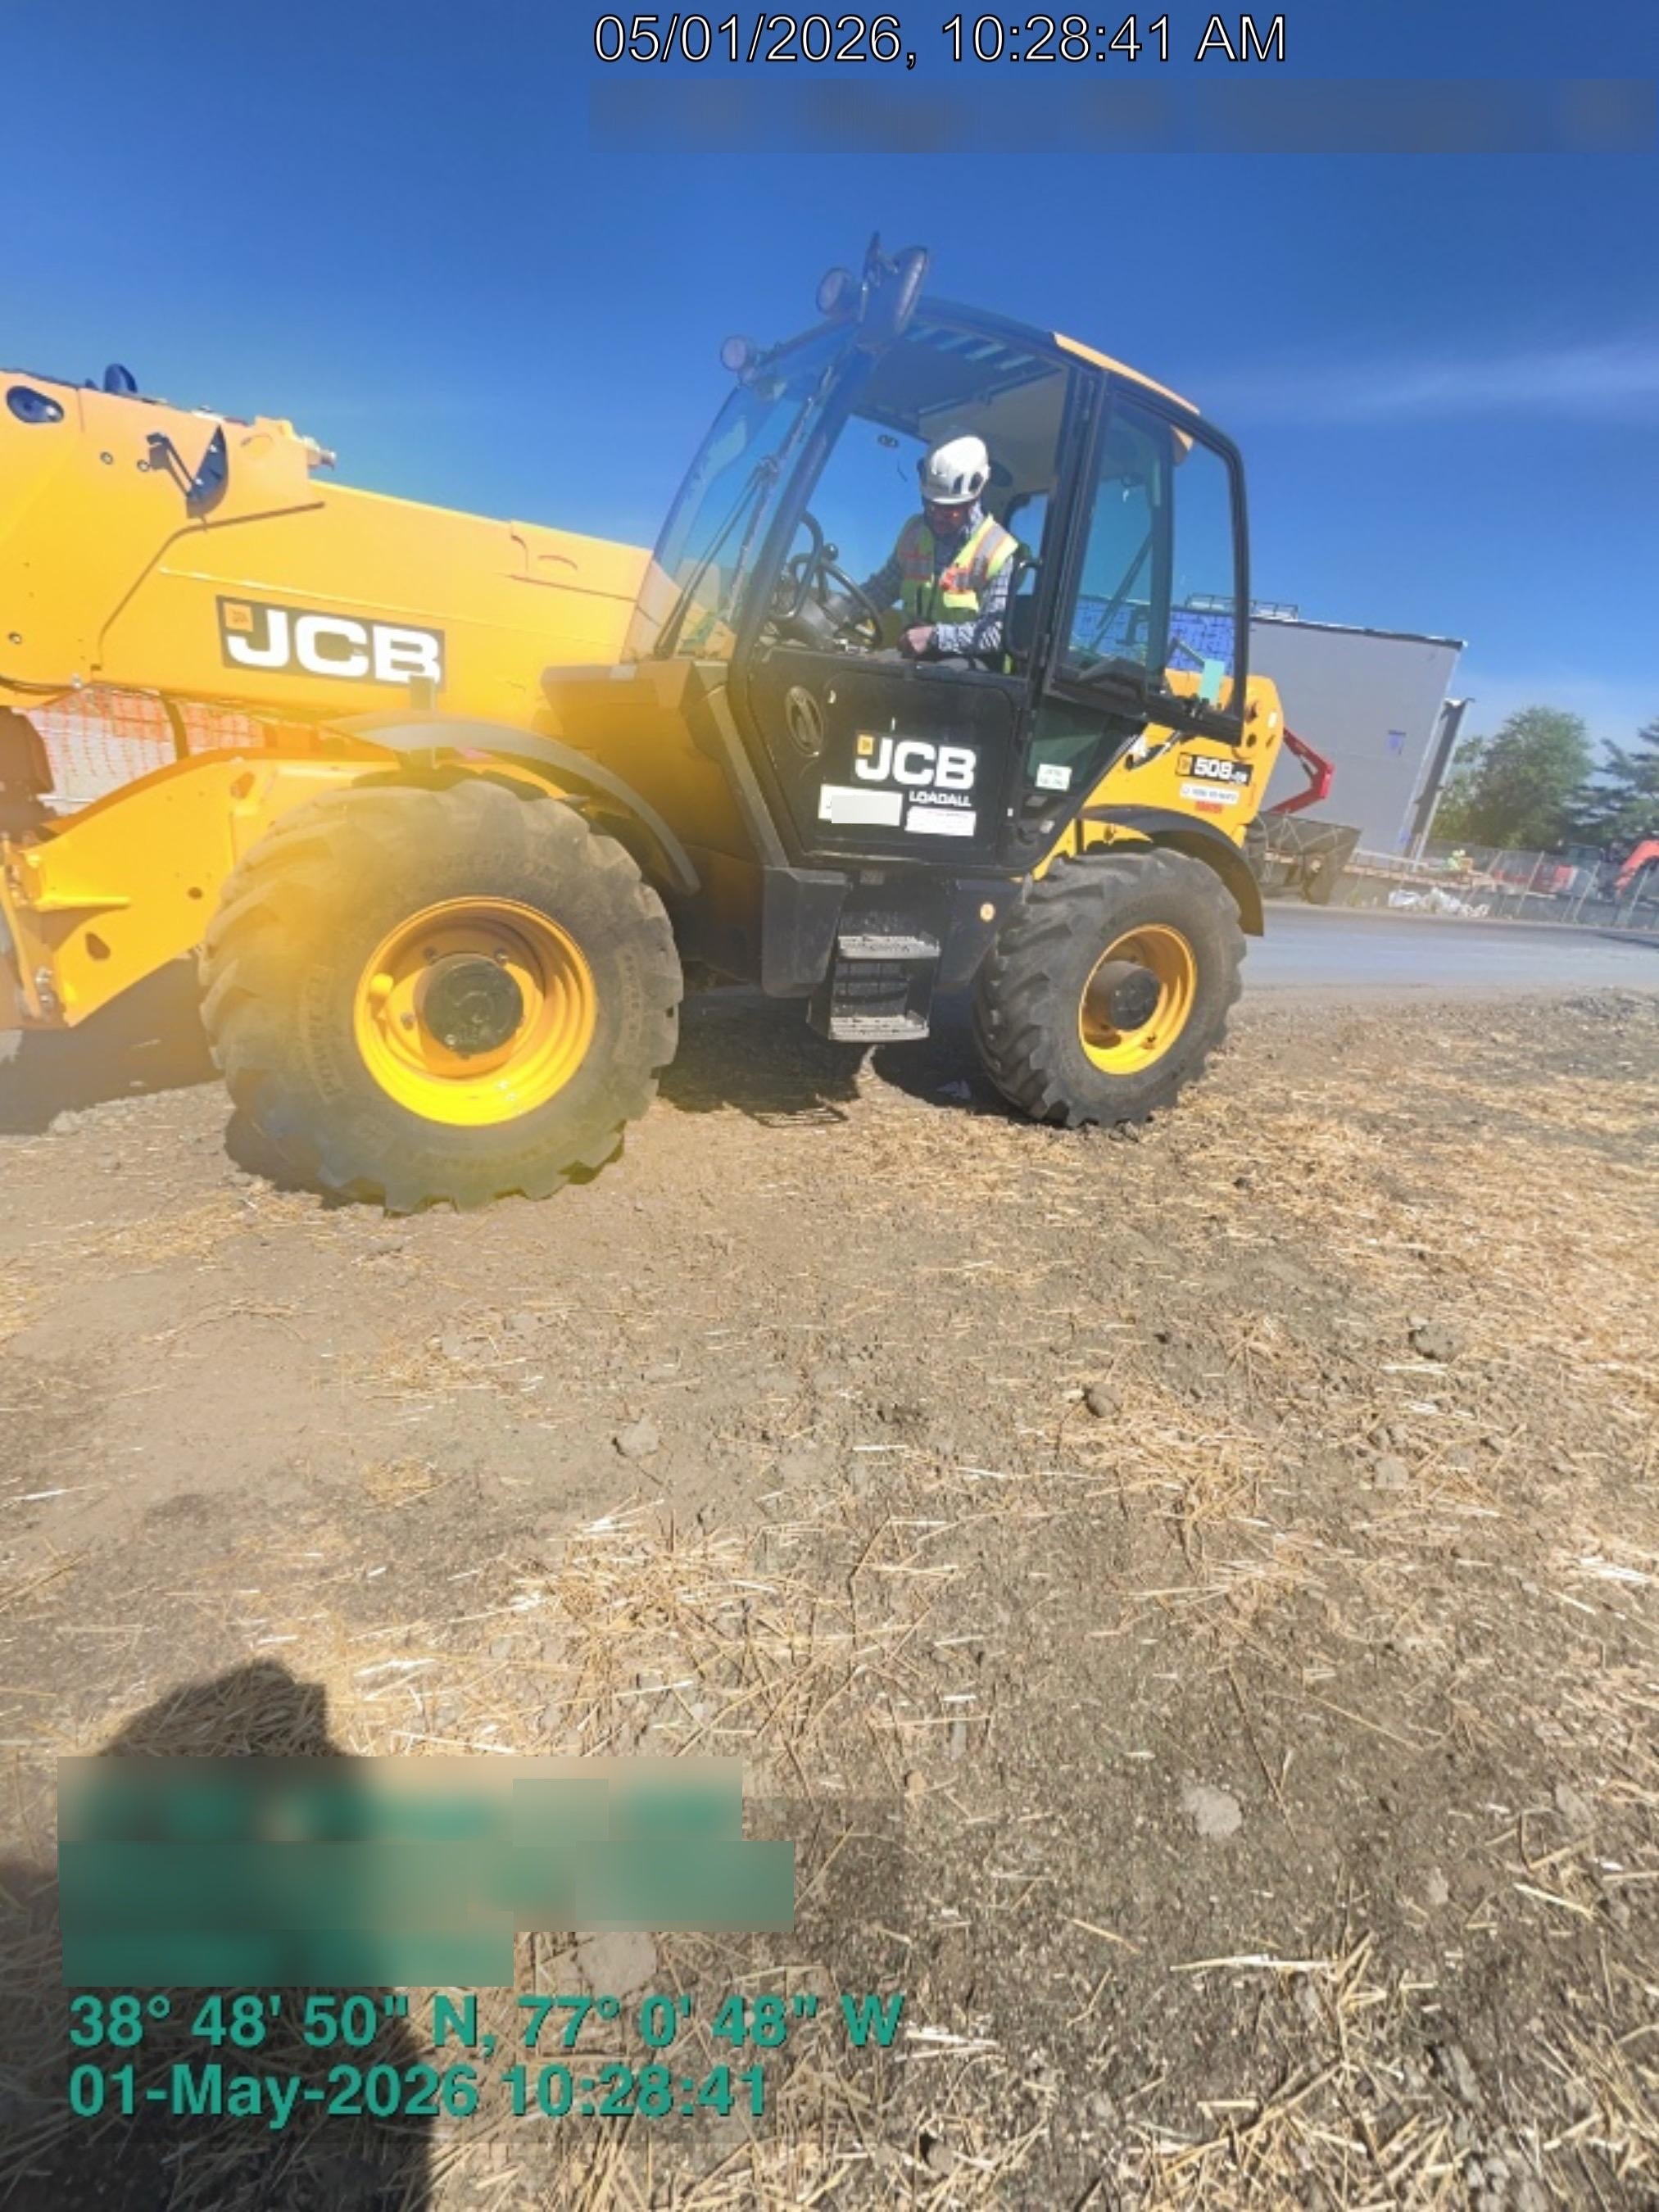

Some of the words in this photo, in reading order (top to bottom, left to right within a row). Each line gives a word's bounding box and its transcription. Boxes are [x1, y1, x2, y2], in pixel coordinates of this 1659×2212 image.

[227, 609, 441, 683] JCB
[854, 737, 977, 791] JCB
[908, 790, 972, 808] LOADALL
